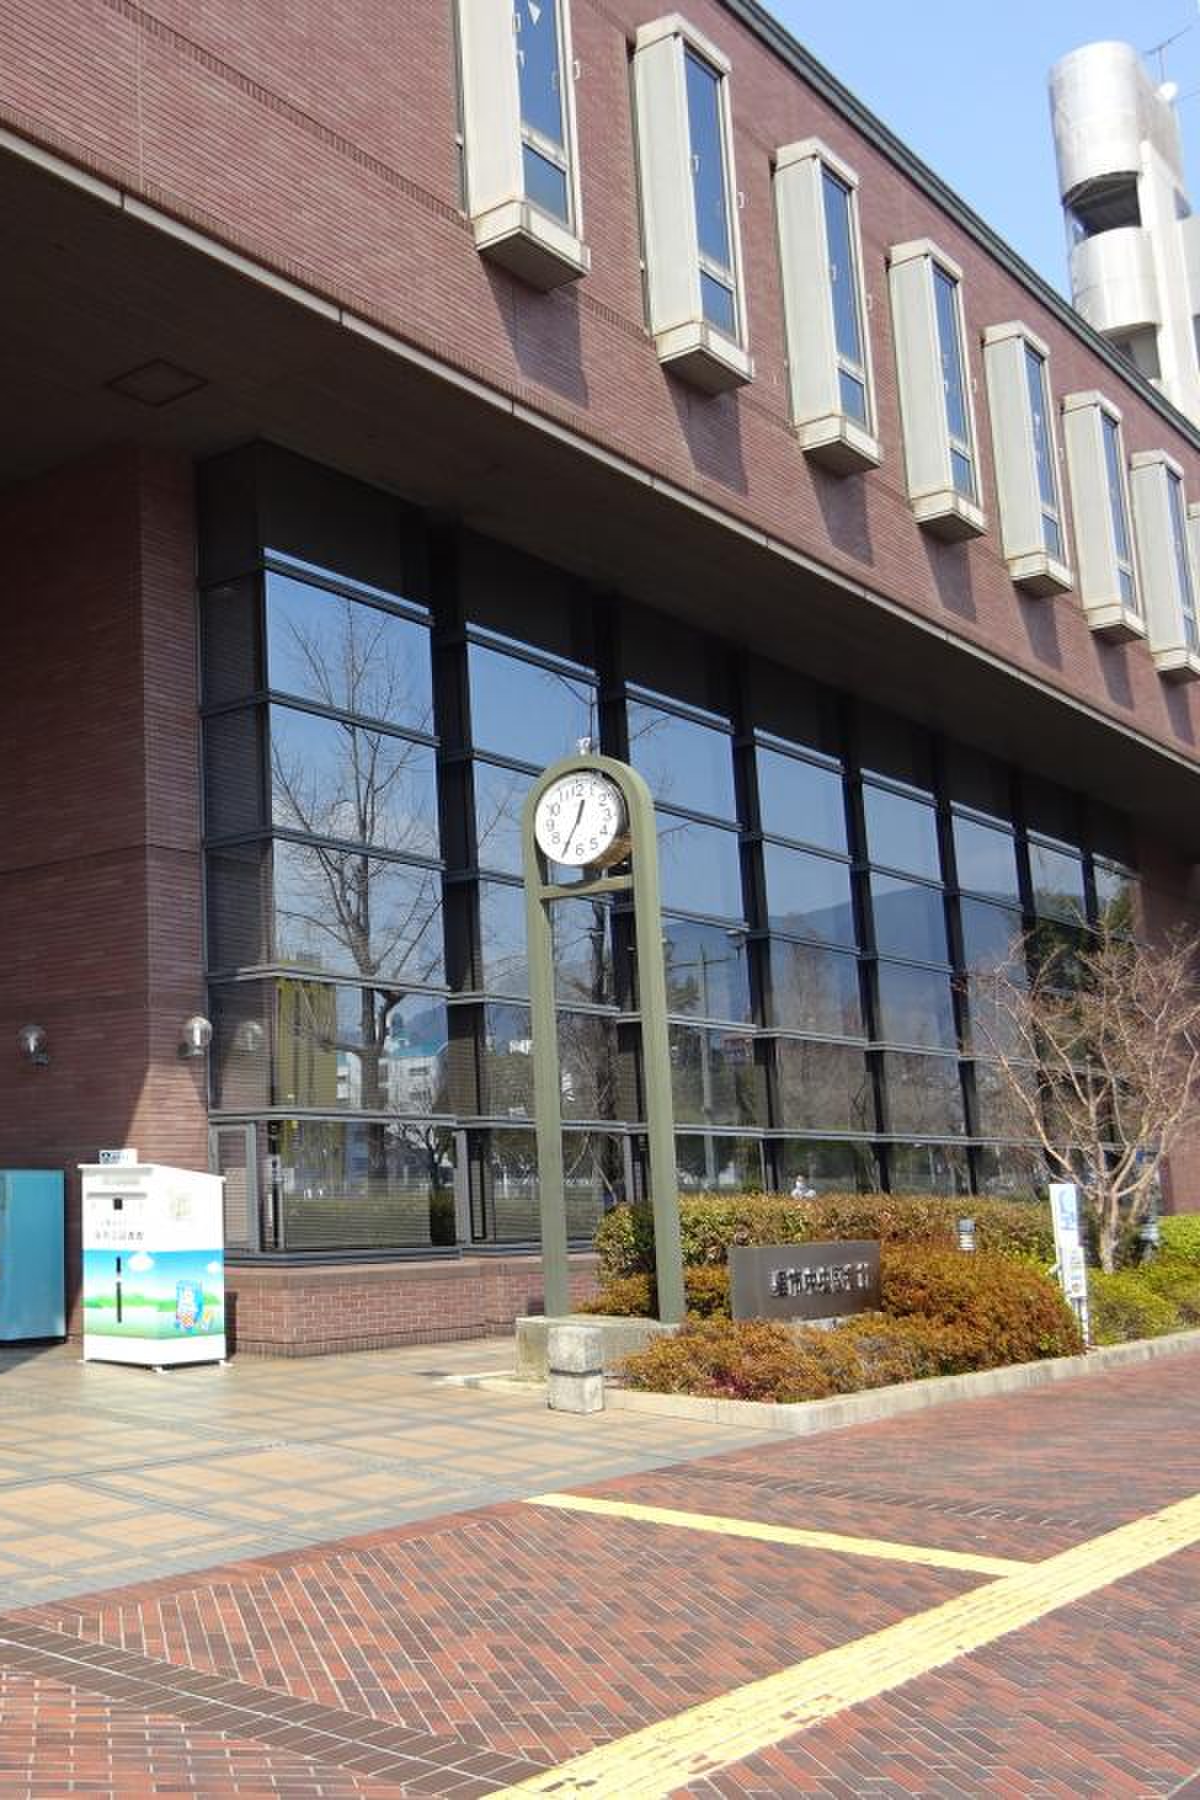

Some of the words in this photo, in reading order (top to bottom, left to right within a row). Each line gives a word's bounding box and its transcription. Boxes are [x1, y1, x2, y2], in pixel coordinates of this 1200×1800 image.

[571, 783, 584, 797] 12
[546, 802, 561, 816] 10
[545, 819, 555, 832] 9
[599, 823, 608, 835] 4
[551, 832, 560, 844] 8
[589, 837, 599, 850] 5
[576, 843, 585, 856] 6
